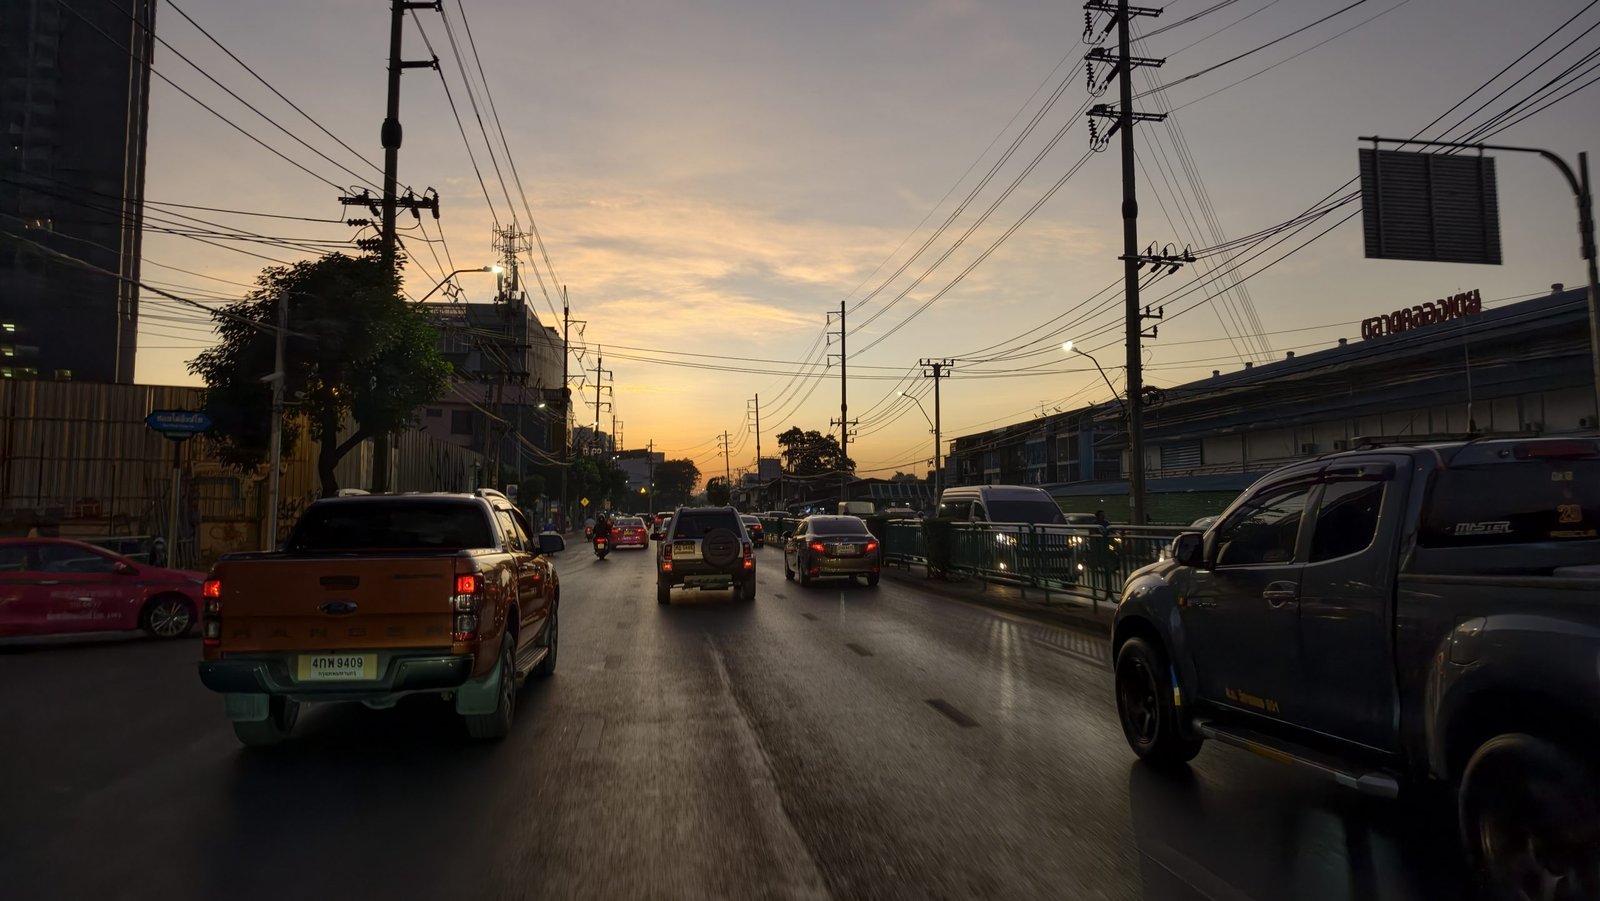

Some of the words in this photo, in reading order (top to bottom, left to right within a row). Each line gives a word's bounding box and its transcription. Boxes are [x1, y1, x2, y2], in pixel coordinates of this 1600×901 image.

[1362, 289, 1482, 340] ตลาดคลองเตย
[232, 625, 442, 638] RANGER
[337, 657, 363, 669] 9409
